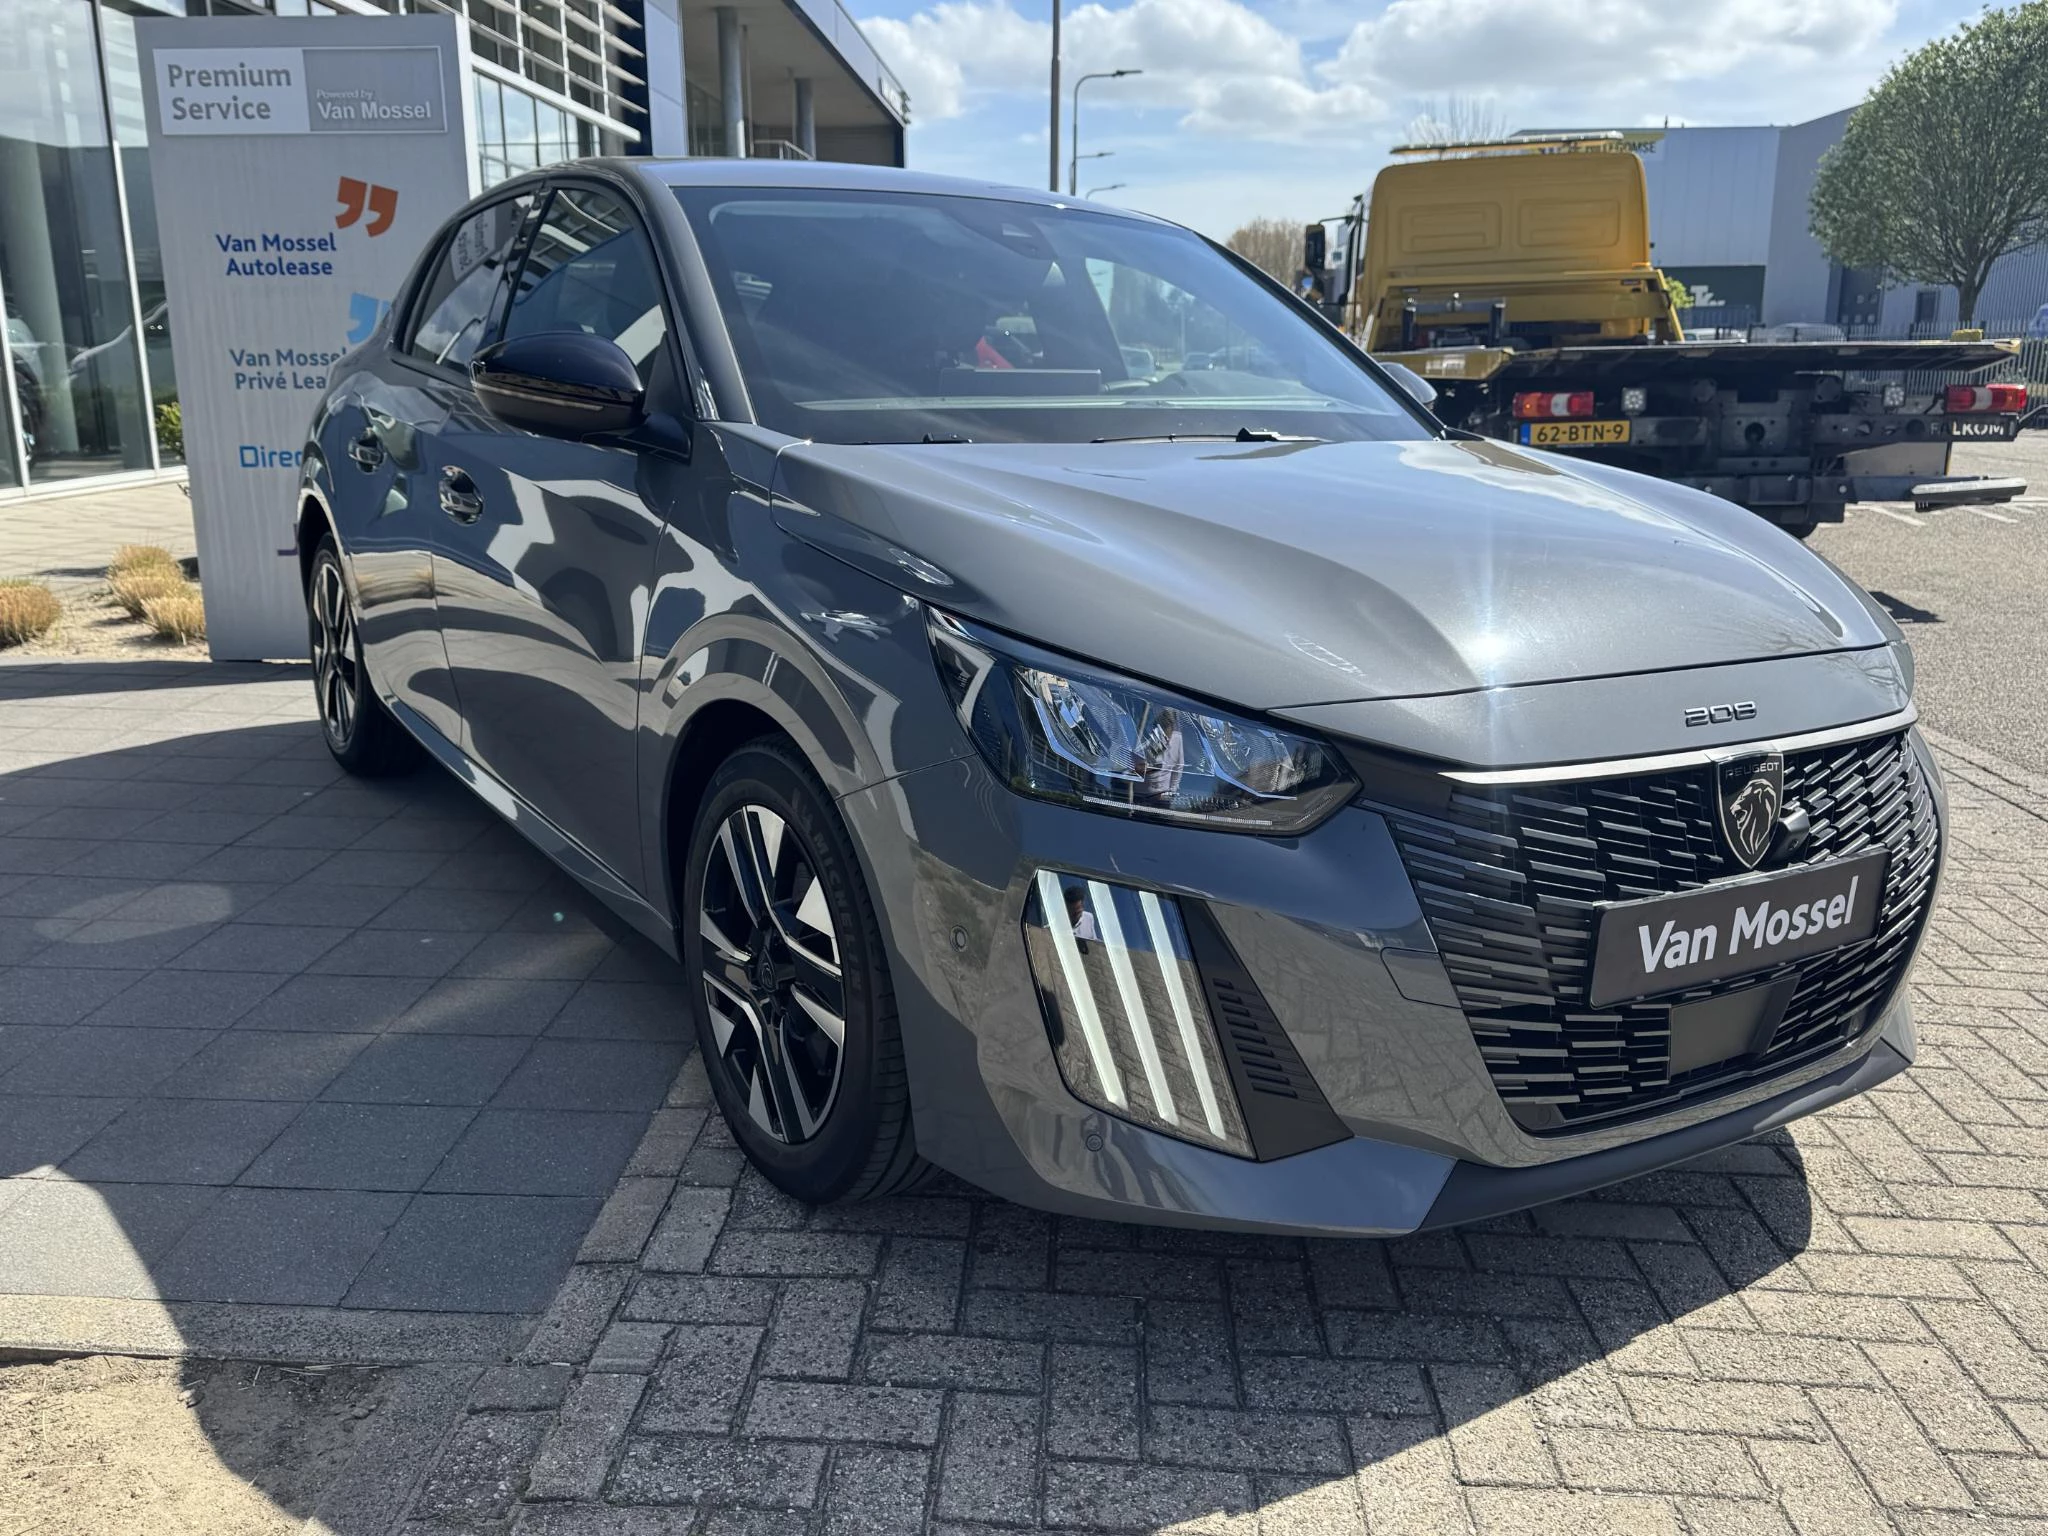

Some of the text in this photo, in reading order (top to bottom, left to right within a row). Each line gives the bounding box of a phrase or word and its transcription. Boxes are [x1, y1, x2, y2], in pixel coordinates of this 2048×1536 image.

[167, 62, 292, 87] Premium
[316, 88, 373, 101] Powered by
[172, 96, 271, 120] Service
[317, 100, 432, 120] Van Mossel
[215, 231, 337, 252] Van Mossel
[225, 256, 333, 276] Autolease
[229, 348, 271, 367] Van
[234, 371, 287, 390] Privé
[1536, 423, 1624, 443] 62-BTN-9
[1685, 700, 1758, 728] 208
[1725, 761, 1780, 779] PEUGEOT
[1637, 875, 1860, 974] Van Mossel
